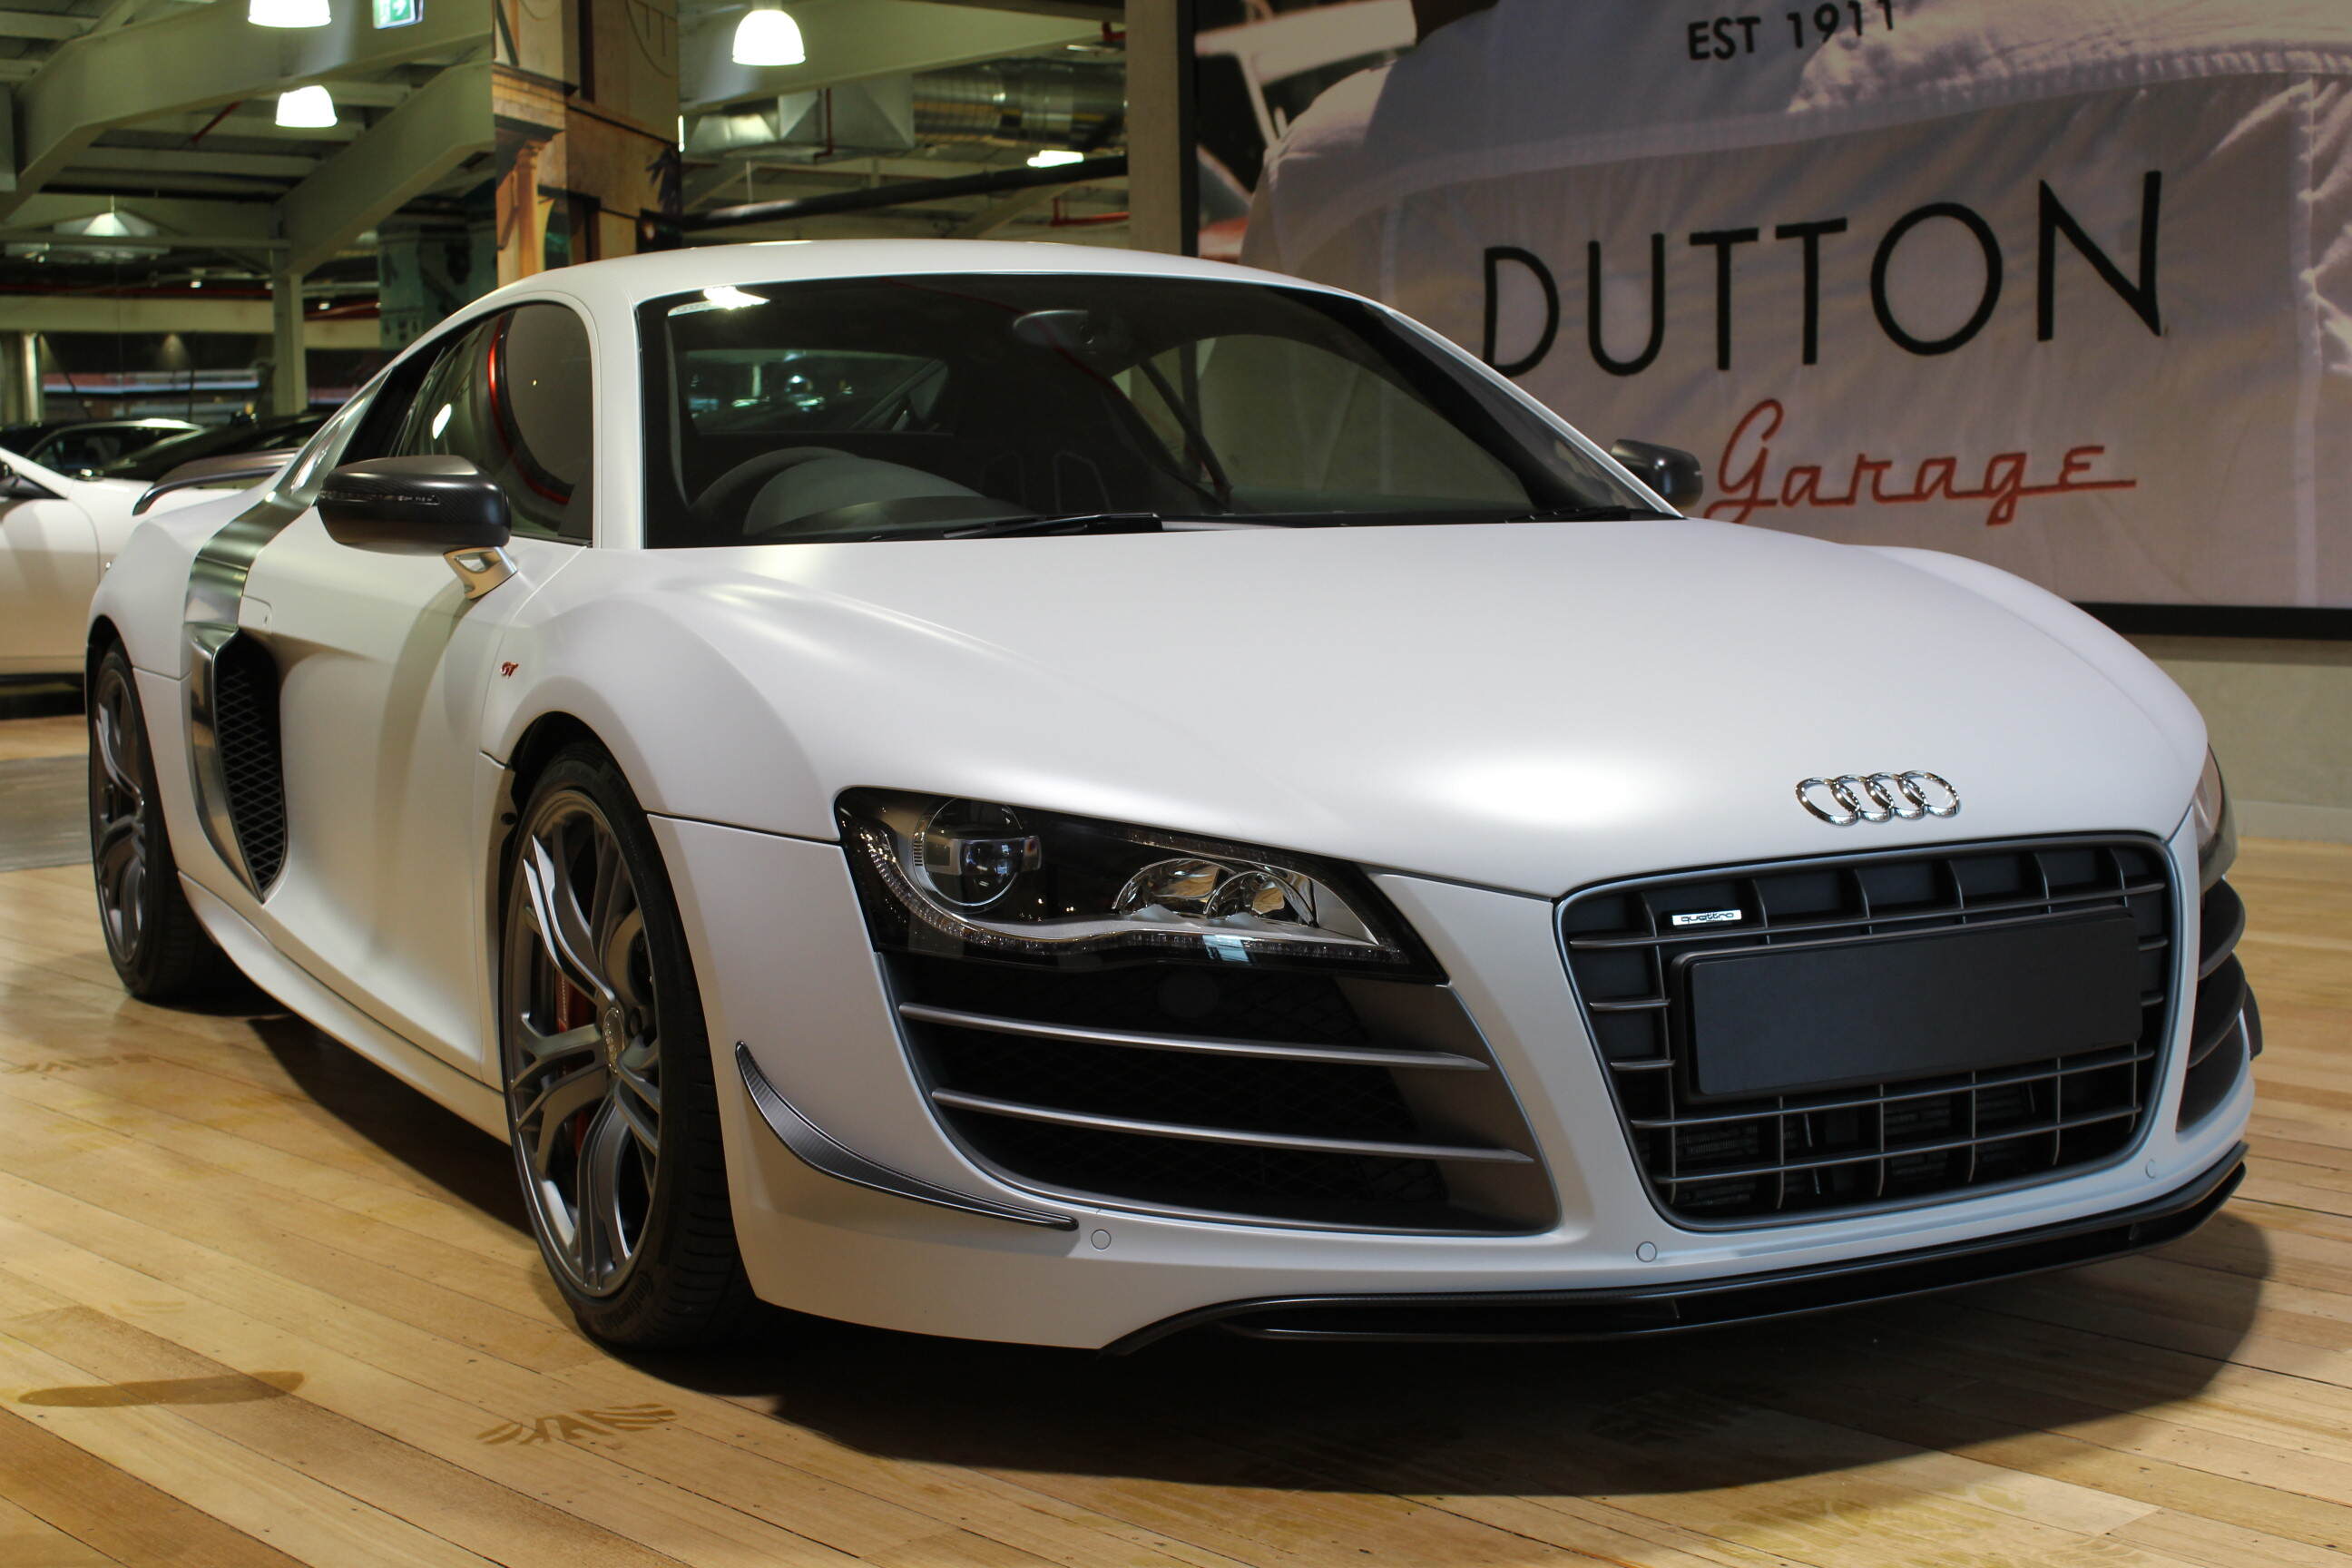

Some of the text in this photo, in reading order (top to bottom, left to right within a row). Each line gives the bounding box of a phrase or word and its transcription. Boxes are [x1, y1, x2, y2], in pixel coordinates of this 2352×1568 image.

[1688, 0, 1894, 60] EST 1911
[1483, 170, 2163, 378] DUTTON
[1703, 398, 2137, 526] Garage
[1681, 911, 1735, 925] quattro
